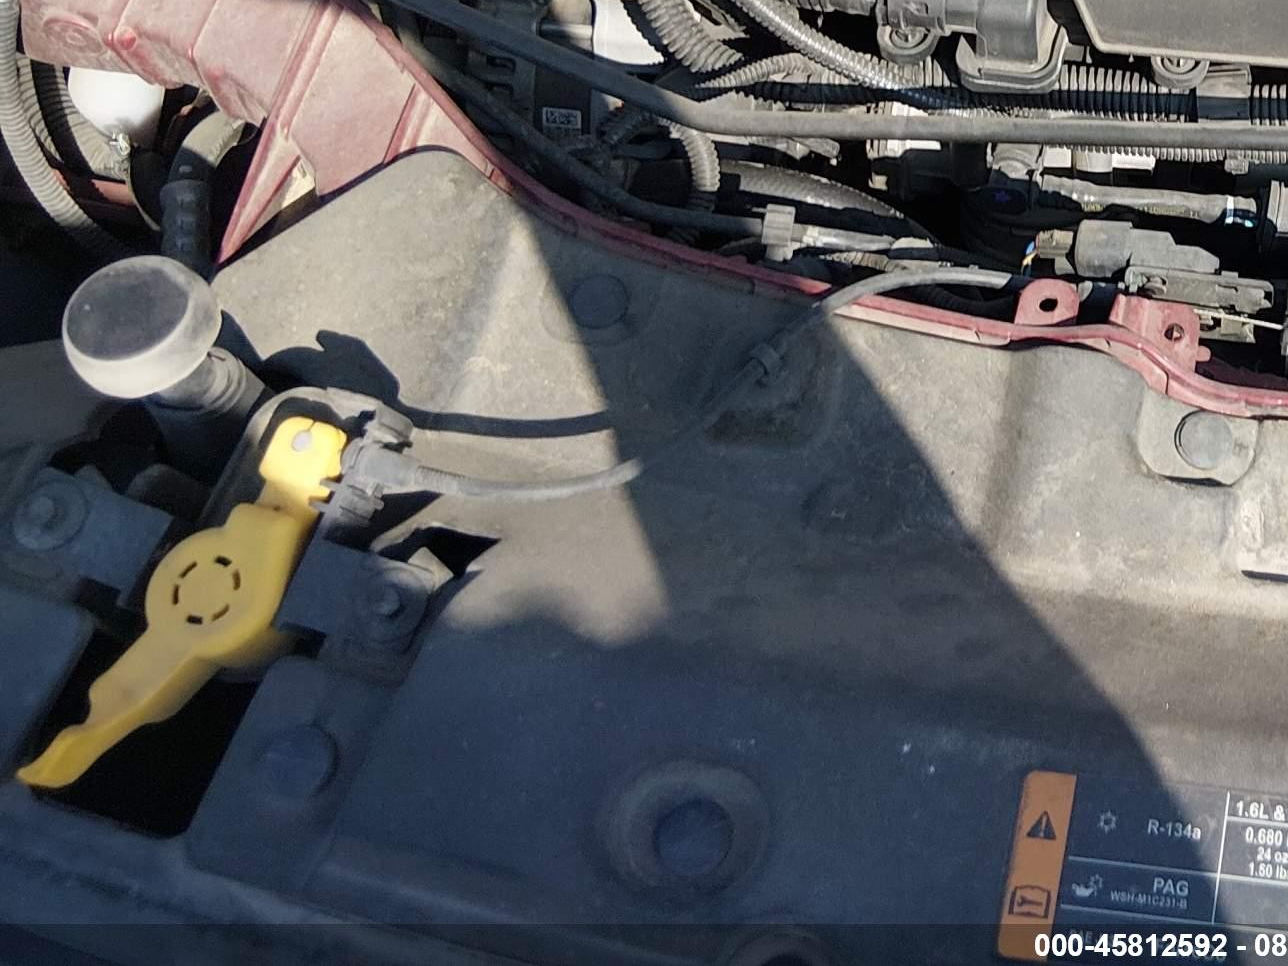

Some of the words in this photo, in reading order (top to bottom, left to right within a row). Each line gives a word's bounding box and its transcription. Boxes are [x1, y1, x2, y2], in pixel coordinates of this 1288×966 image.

[1236, 800, 1269, 820] 1.6L
[1274, 806, 1286, 822] &
[1147, 818, 1202, 840] R-134a
[1245, 826, 1284, 847] 0.680
[1256, 846, 1272, 862] 24
[1274, 851, 1288, 864] oz
[1153, 876, 1190, 897] PAG
